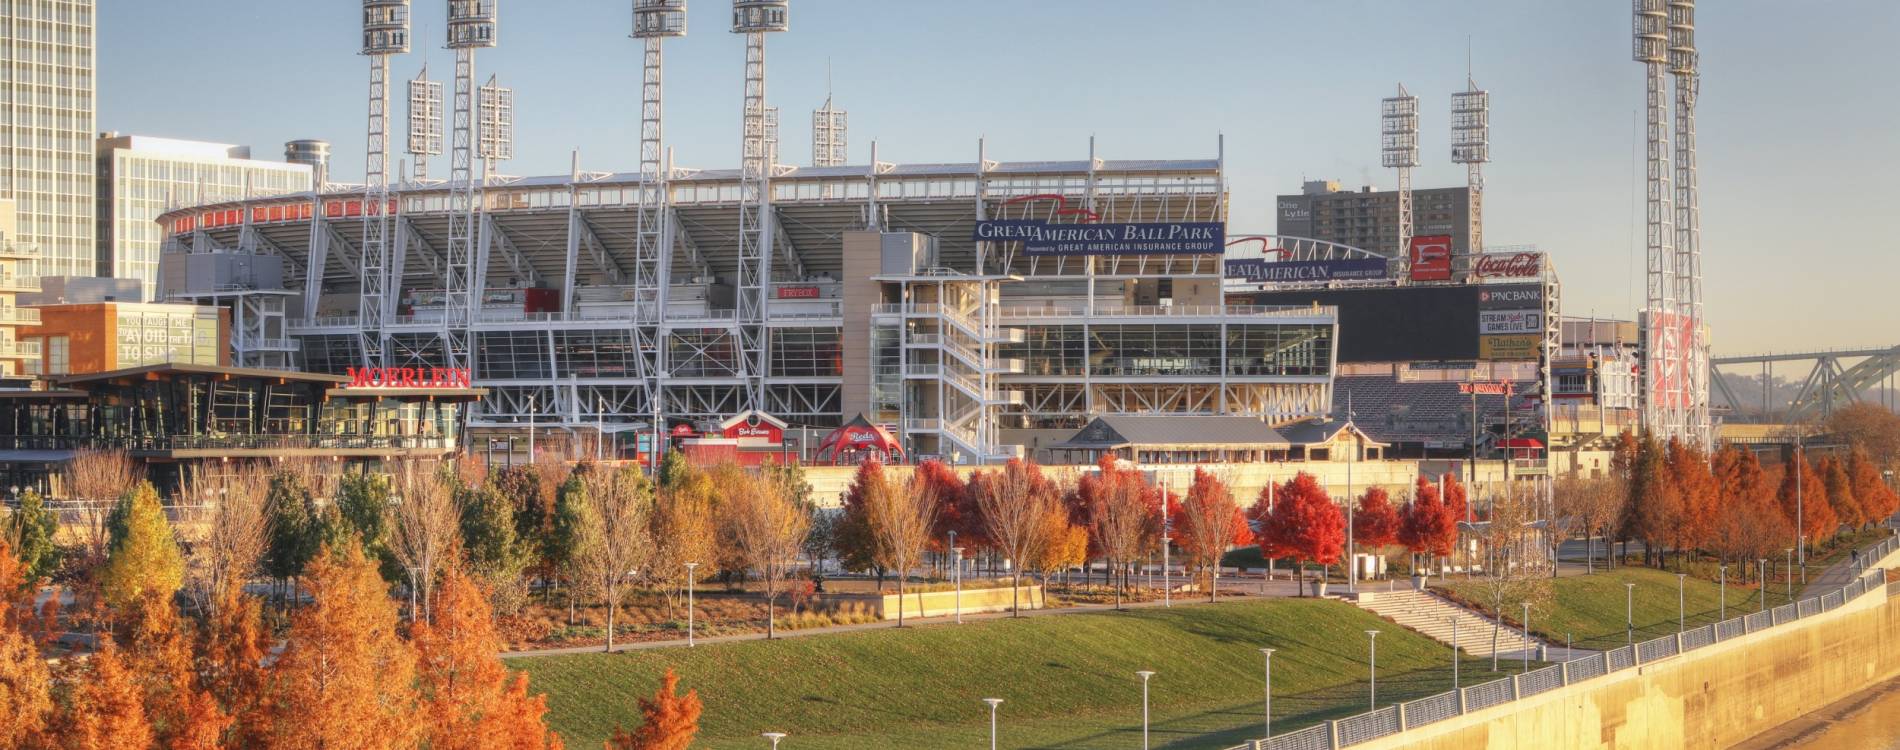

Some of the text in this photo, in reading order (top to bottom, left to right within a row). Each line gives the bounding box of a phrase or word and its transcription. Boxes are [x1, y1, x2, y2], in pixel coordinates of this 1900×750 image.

[1278, 201, 1298, 209] One
[1284, 209, 1310, 218] Lytle
[978, 223, 1214, 241] GREAT AMERICAN BALL PARK
[1058, 243, 1084, 252] GREAT
[1087, 243, 1131, 252] AMERICAN
[1134, 242, 1182, 251] INSURANCE
[1185, 242, 1214, 250] GROUP
[1250, 265, 1328, 280] AMERICAN
[1332, 270, 1363, 278] INSURANCE
[1364, 269, 1383, 277] GROUP
[1491, 290, 1540, 301] PNC BANK
[126, 318, 141, 327] YOU
[175, 318, 188, 328] ME
[1481, 313, 1506, 323] STREAM
[1487, 322, 1525, 331] GAMES LIVE
[126, 328, 167, 344] AVOID
[122, 345, 142, 360] TO
[346, 367, 471, 388] MOERLEIN
[850, 431, 873, 441] Reds
